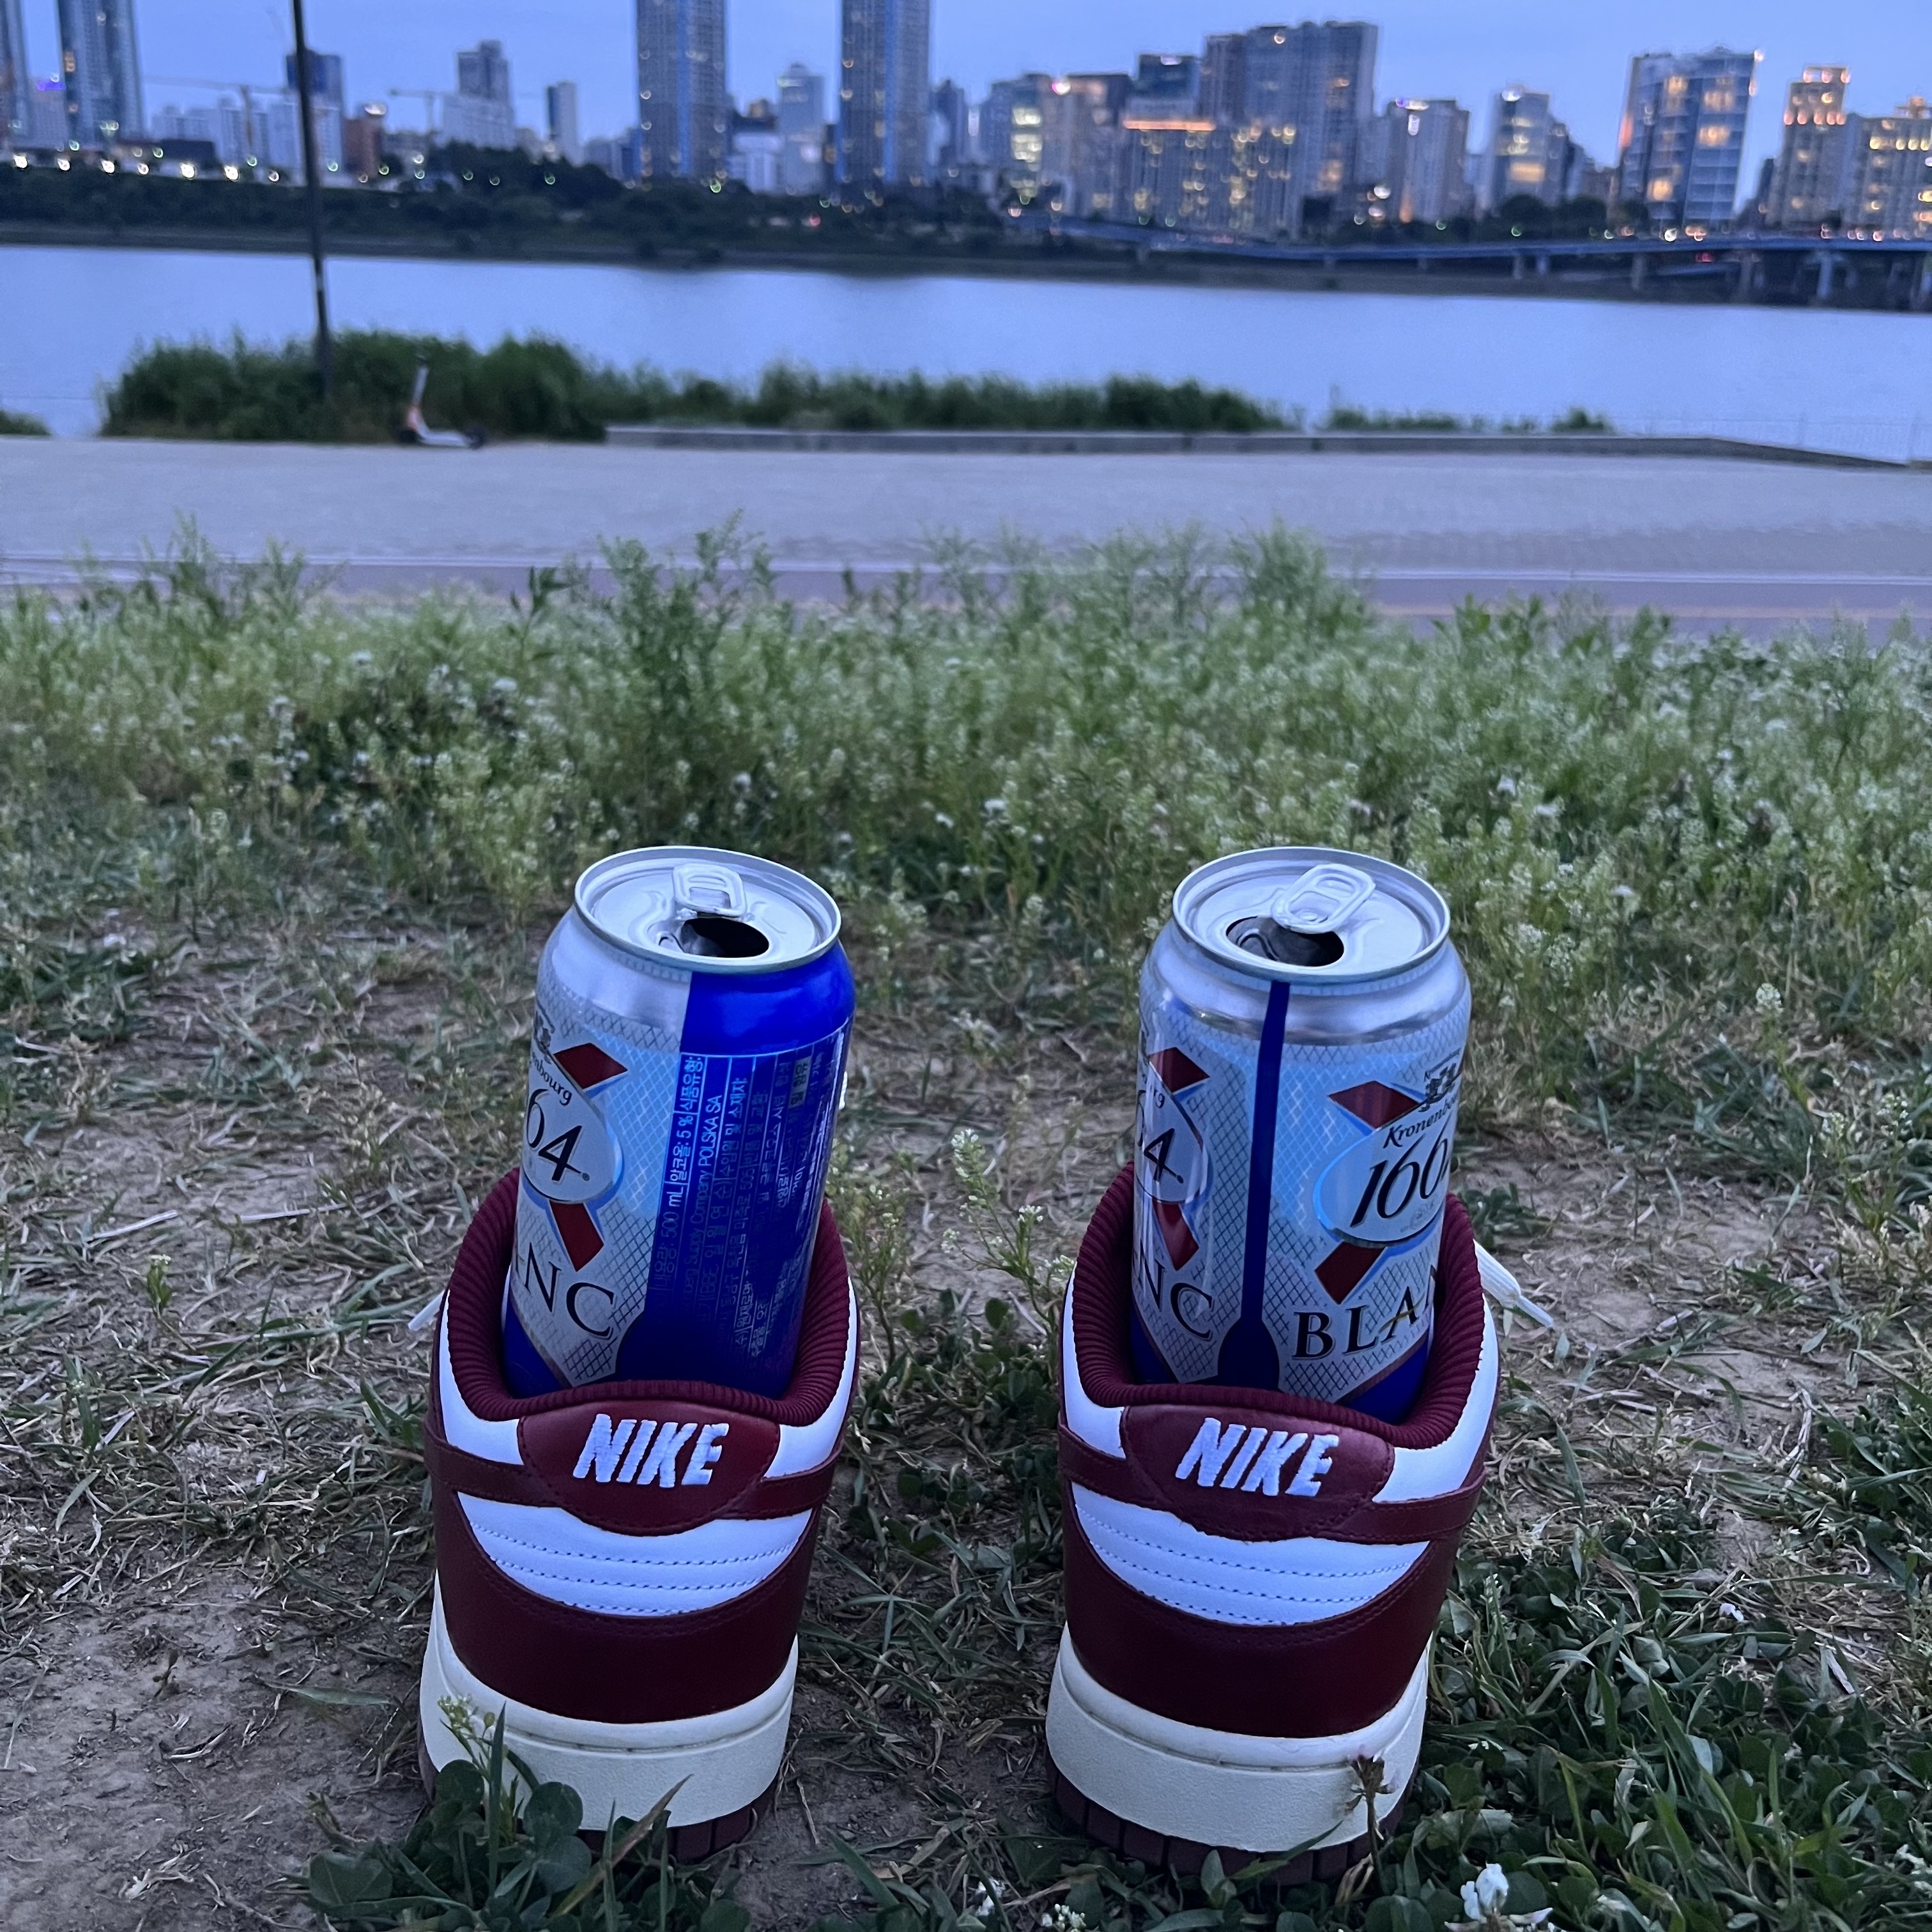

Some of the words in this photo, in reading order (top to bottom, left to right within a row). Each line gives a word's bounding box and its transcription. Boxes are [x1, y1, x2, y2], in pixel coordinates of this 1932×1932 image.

[680, 1055, 703, 1110] 식품유형:
[707, 1092, 722, 1113] SA
[678, 1129, 691, 1138] 5
[679, 1114, 693, 1126] %
[725, 1121, 741, 1137] 및
[699, 1114, 719, 1167] POLSKA
[719, 1138, 739, 1176] 수입원
[670, 1141, 691, 1182] 알코올:
[1349, 1110, 1453, 1227] 166
[666, 1184, 683, 1206] mL
[691, 1170, 713, 1225] Company
[714, 1179, 733, 1200] 순)
[661, 1210, 680, 1238] 500
[711, 1204, 729, 1220] 연
[685, 1227, 704, 1266] Supply
[705, 1242, 723, 1259] 일
[573, 1414, 730, 1488] NIKE
[1175, 1417, 1339, 1497] NIKE
